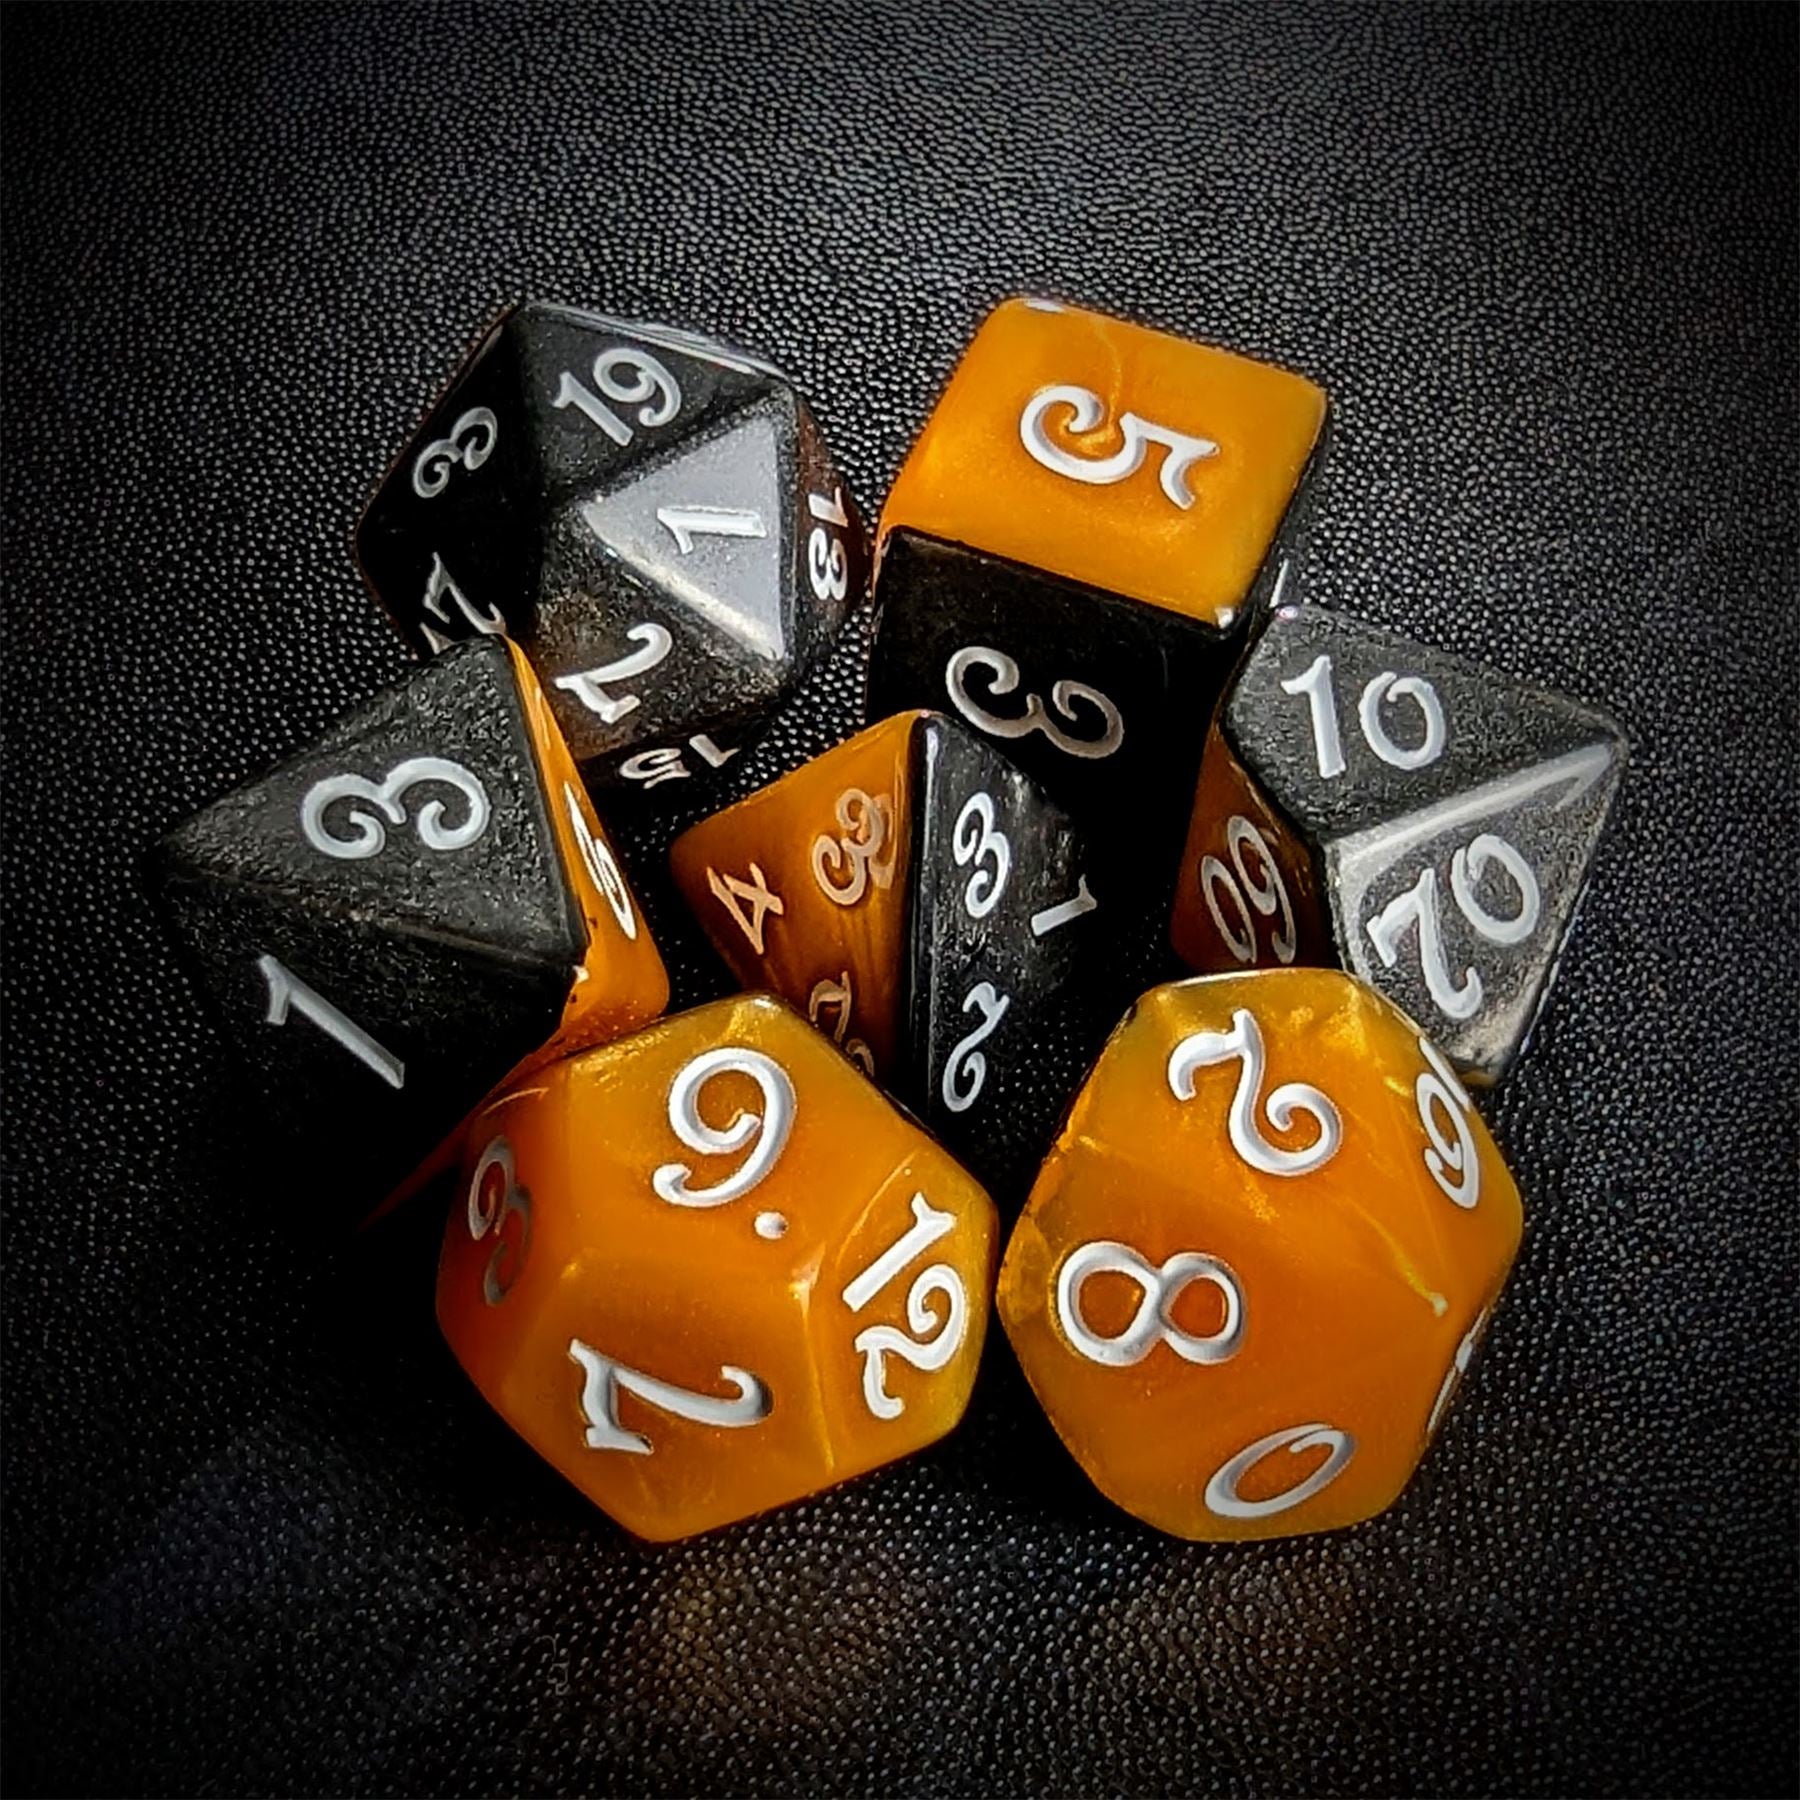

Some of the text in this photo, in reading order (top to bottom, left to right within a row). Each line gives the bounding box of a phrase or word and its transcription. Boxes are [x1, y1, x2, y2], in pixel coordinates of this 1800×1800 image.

[411, 405, 499, 499] 3
[553, 347, 682, 447] 19
[1019, 384, 1221, 512] 5
[656, 504, 768, 555] 1
[808, 486, 849, 601] 13
[619, 733, 742, 790] 15
[945, 645, 1124, 760] 3
[1280, 654, 1446, 780] 10
[302, 756, 491, 860] 3
[811, 787, 886, 906] 3
[952, 791, 1012, 919] 3
[706, 862, 785, 956] 4
[1030, 874, 1099, 937] 1
[1366, 833, 1541, 1020] 70
[259, 953, 405, 1090] 1
[942, 980, 1011, 1114] 2
[1167, 1008, 1343, 1177] 2
[841, 1191, 969, 1420] 12
[1056, 1240, 1248, 1368] 8
[568, 1338, 775, 1456] 7
[1203, 1422, 1358, 1519] 0
